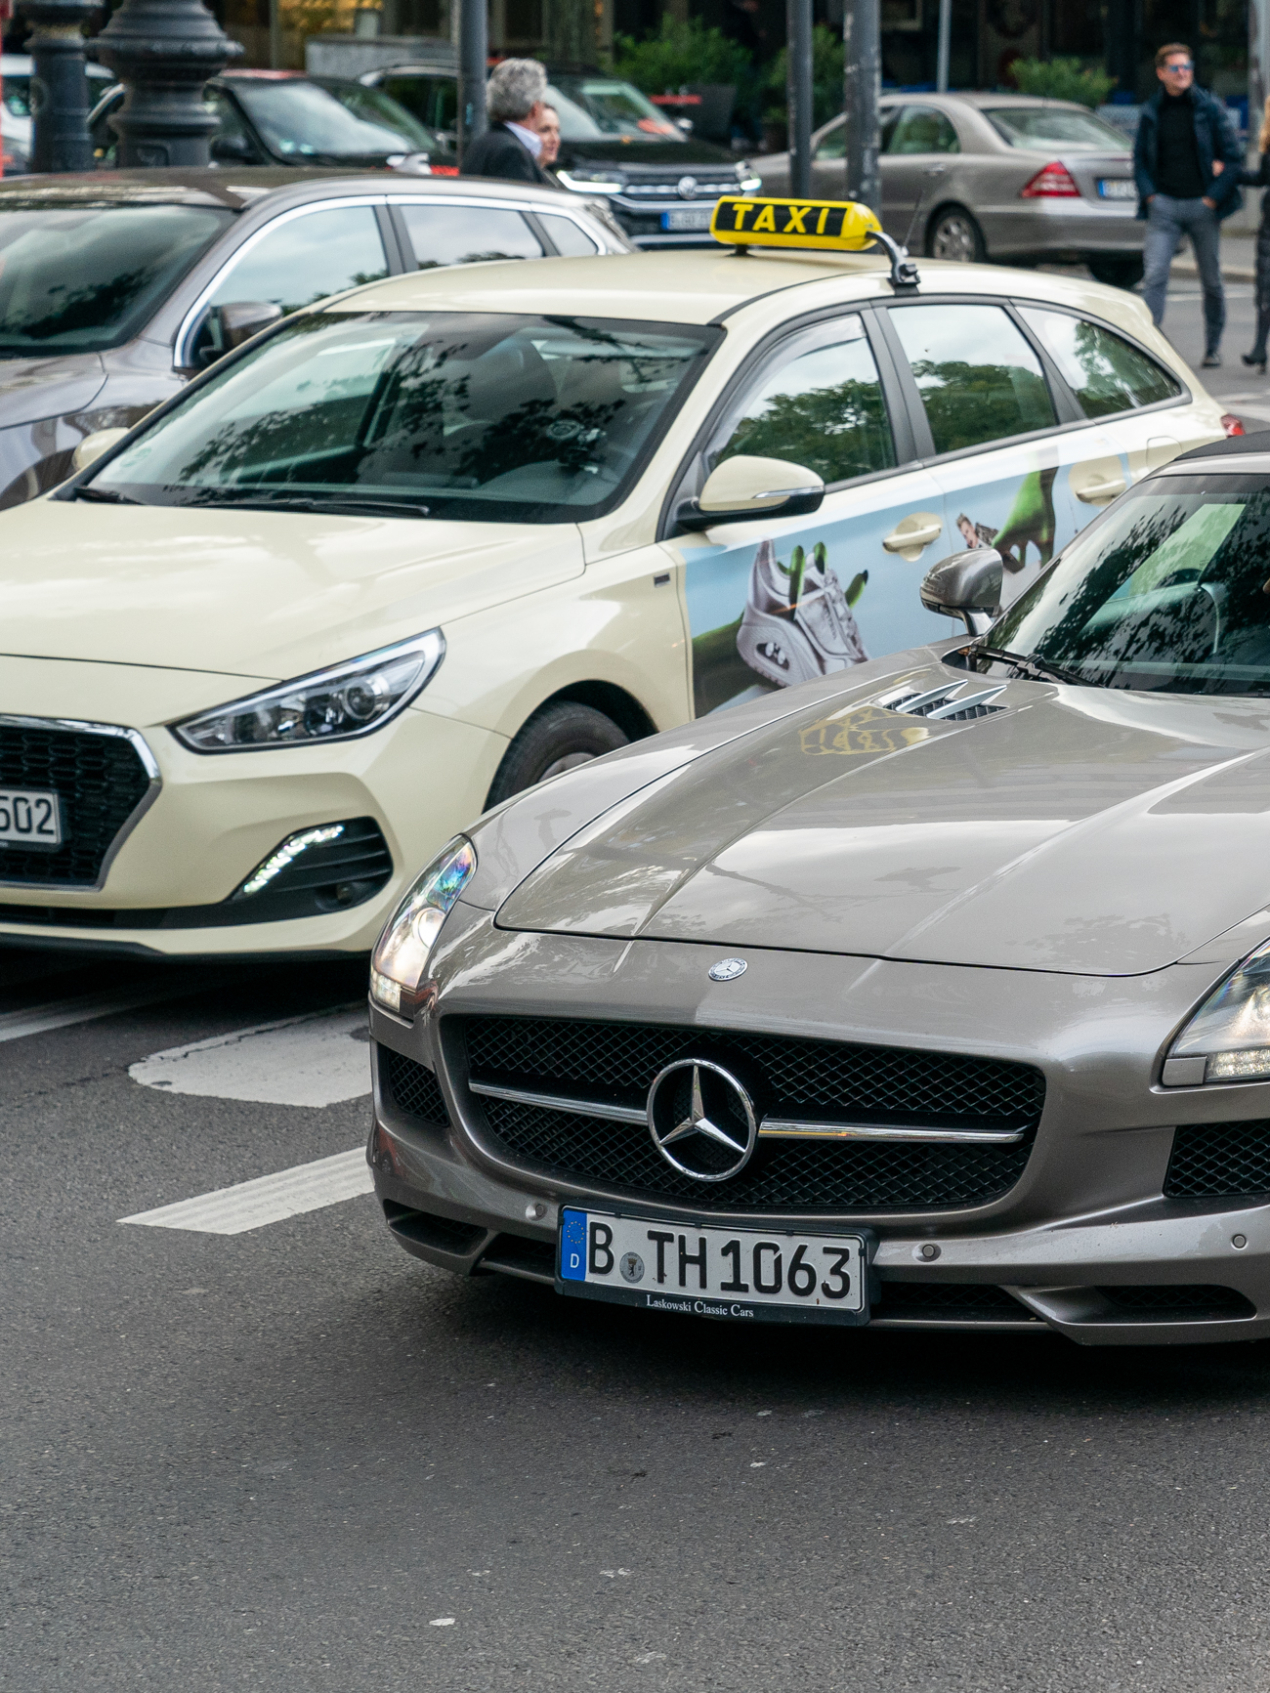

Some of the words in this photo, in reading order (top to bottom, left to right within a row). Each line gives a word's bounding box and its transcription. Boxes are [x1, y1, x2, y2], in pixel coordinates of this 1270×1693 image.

[732, 203, 830, 234] TAXI
[570, 1253, 580, 1268] D
[588, 1221, 615, 1275] B
[646, 1294, 691, 1312] Laskowski
[694, 1301, 728, 1315] Classic
[730, 1304, 754, 1317] Cars
